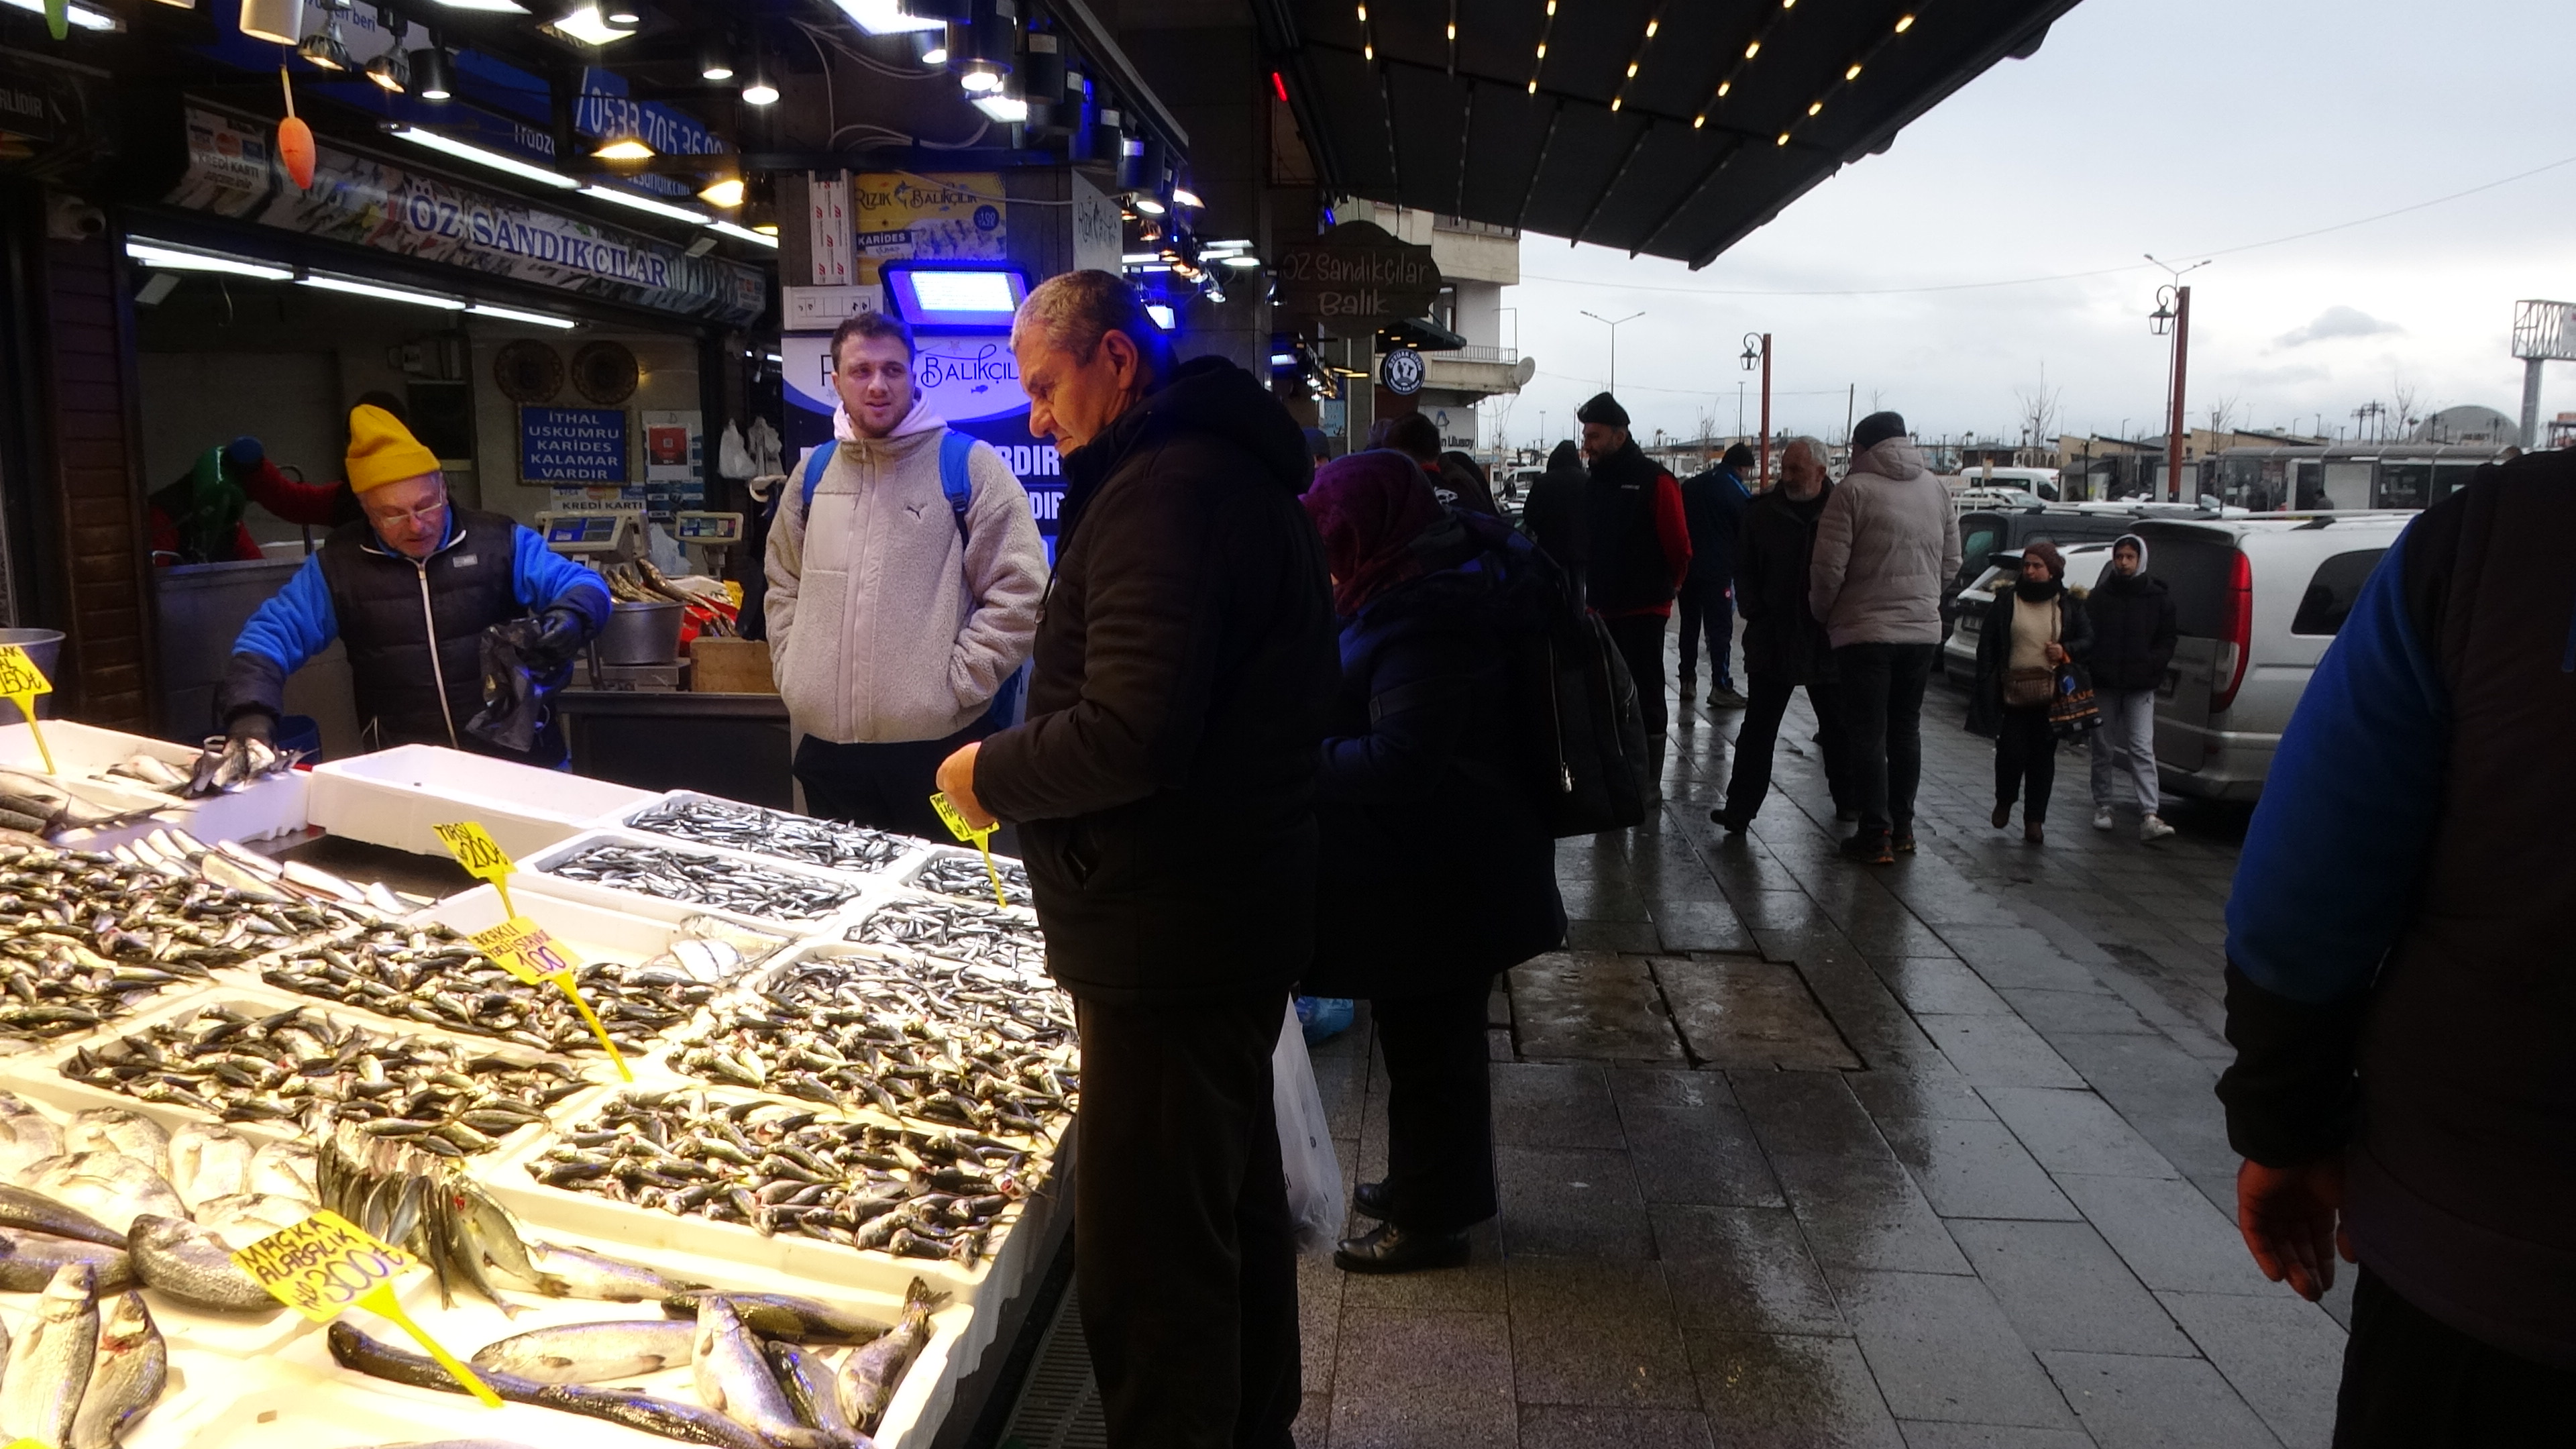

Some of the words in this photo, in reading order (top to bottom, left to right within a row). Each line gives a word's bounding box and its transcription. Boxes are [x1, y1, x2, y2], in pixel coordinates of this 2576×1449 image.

[353, 7, 375, 32] beri
[645, 109, 678, 156] 705
[409, 184, 462, 239] ÖZ
[857, 232, 906, 246] KARİDES
[1318, 288, 1390, 317] Balık
[921, 344, 1020, 388] BALIKÇIL
[549, 411, 600, 425] İTHAL
[529, 426, 619, 439] USKUMRU
[537, 439, 612, 452] KARİDES
[531, 453, 618, 466] KALAMAR
[541, 468, 608, 479] VARDIR
[562, 501, 601, 510] KREDİ
[605, 502, 642, 510] KARTI
[516, 945, 566, 977] 100
